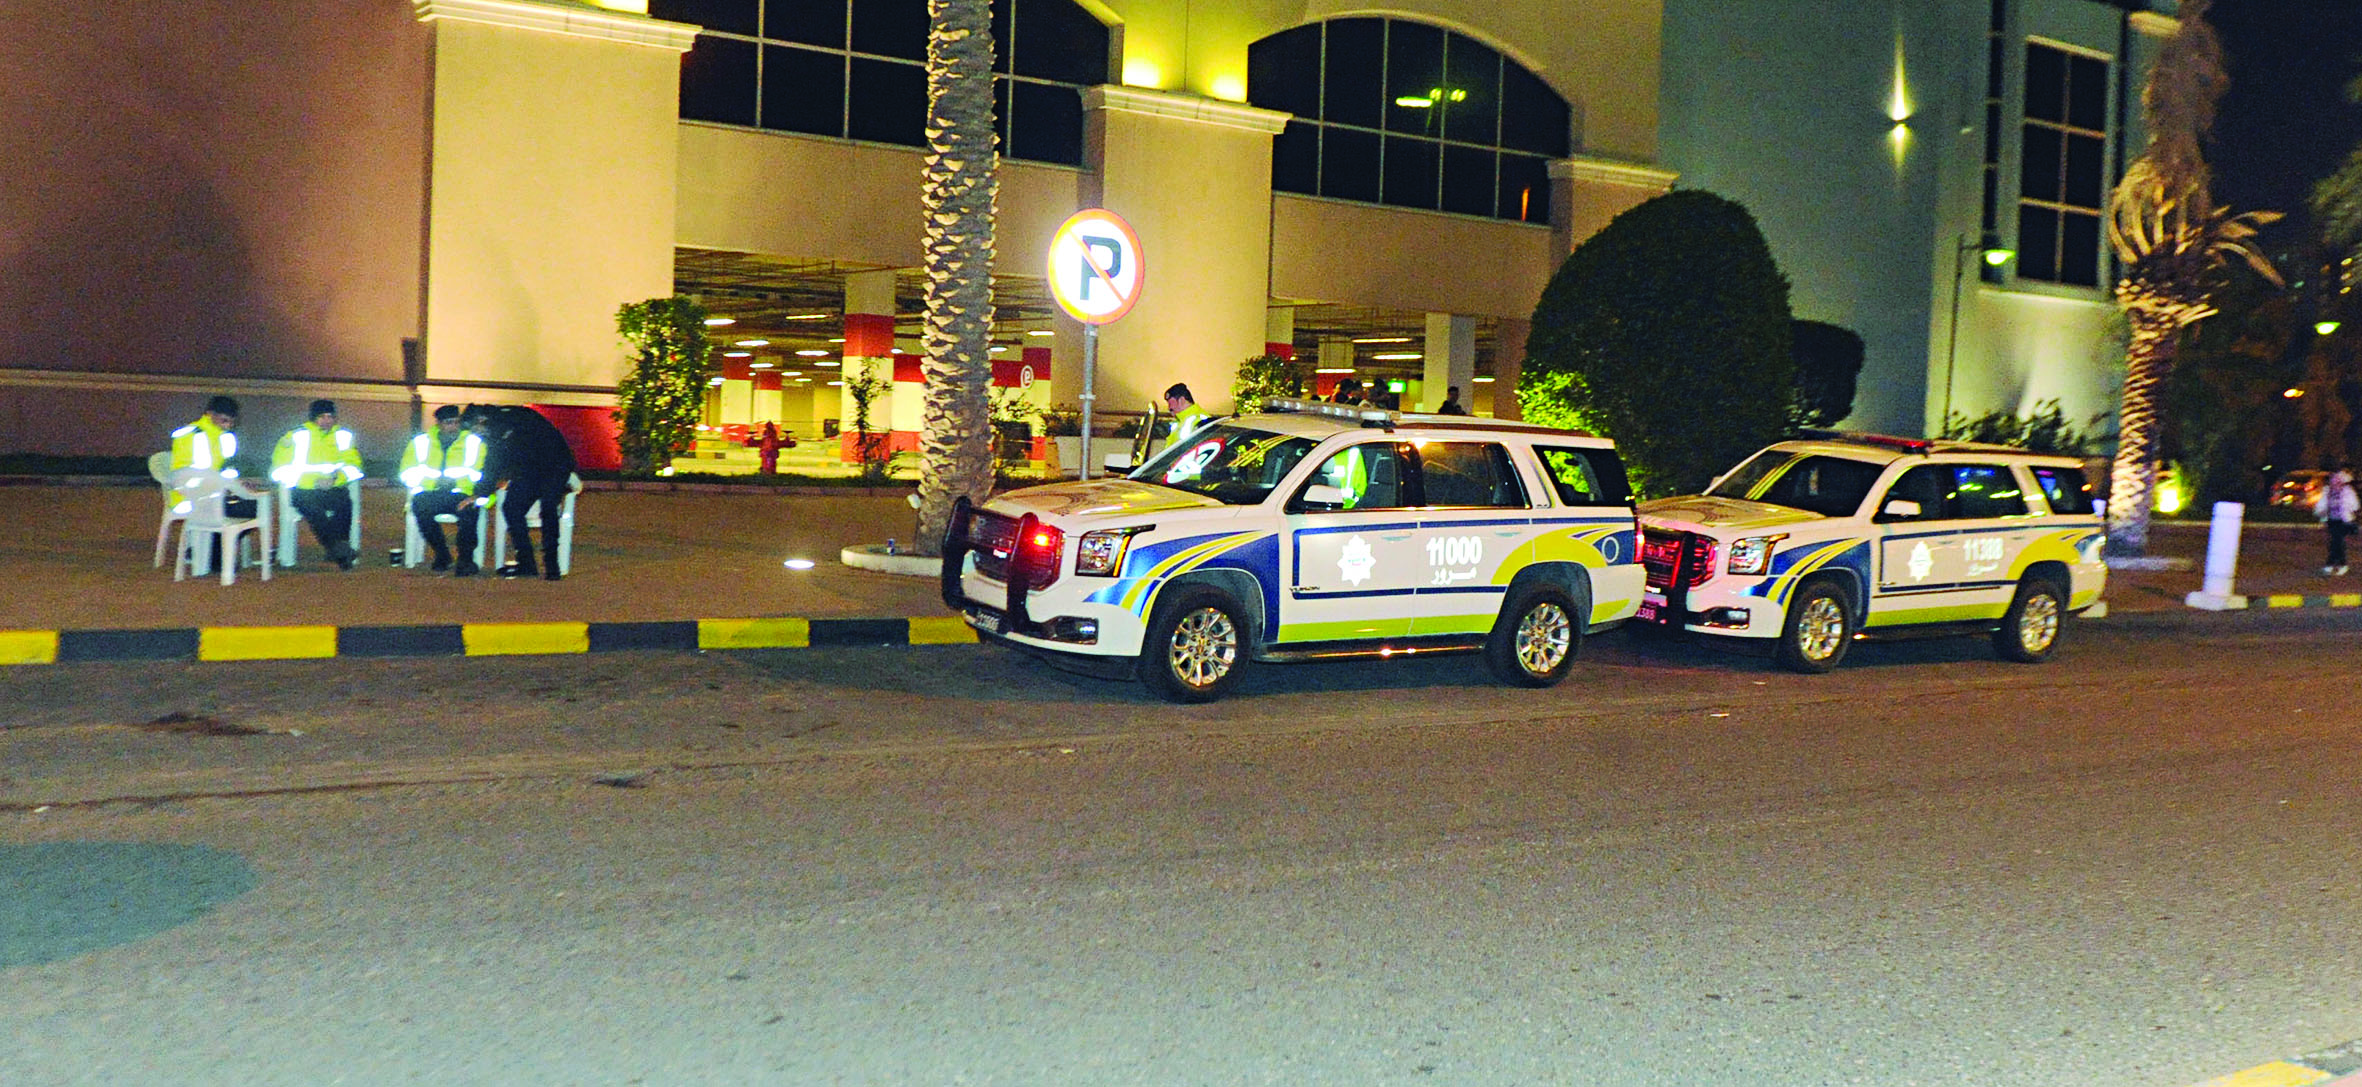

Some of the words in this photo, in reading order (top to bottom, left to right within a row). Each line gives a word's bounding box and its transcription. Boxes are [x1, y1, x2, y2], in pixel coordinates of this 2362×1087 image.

[1080, 235, 1122, 301] P
[1426, 536, 1483, 566] 11000
[1431, 566, 1477, 586] مرور
